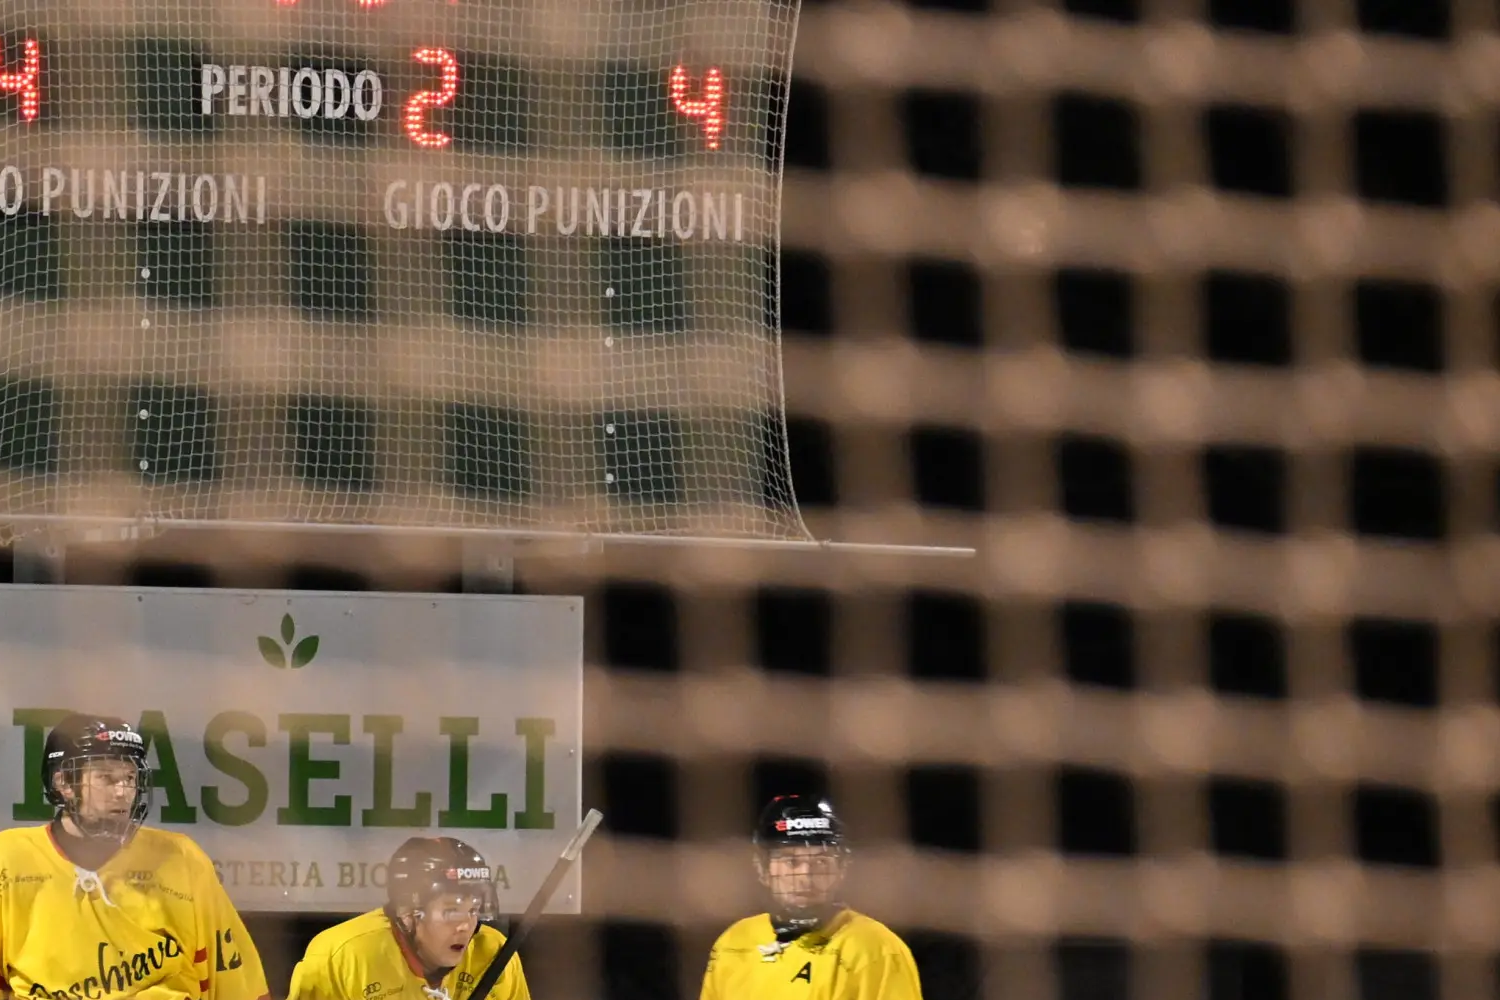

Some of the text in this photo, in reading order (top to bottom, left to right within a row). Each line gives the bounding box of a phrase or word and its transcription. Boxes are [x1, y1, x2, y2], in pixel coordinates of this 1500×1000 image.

[201, 63, 382, 120] PERIODO
[405, 47, 458, 147] 2
[672, 65, 722, 149] 4
[41, 166, 267, 225] PUNIZIONI
[385, 178, 743, 241] GIOCO PUNIZIONI
[211, 860, 325, 888] STERIA
[791, 961, 811, 984] A
